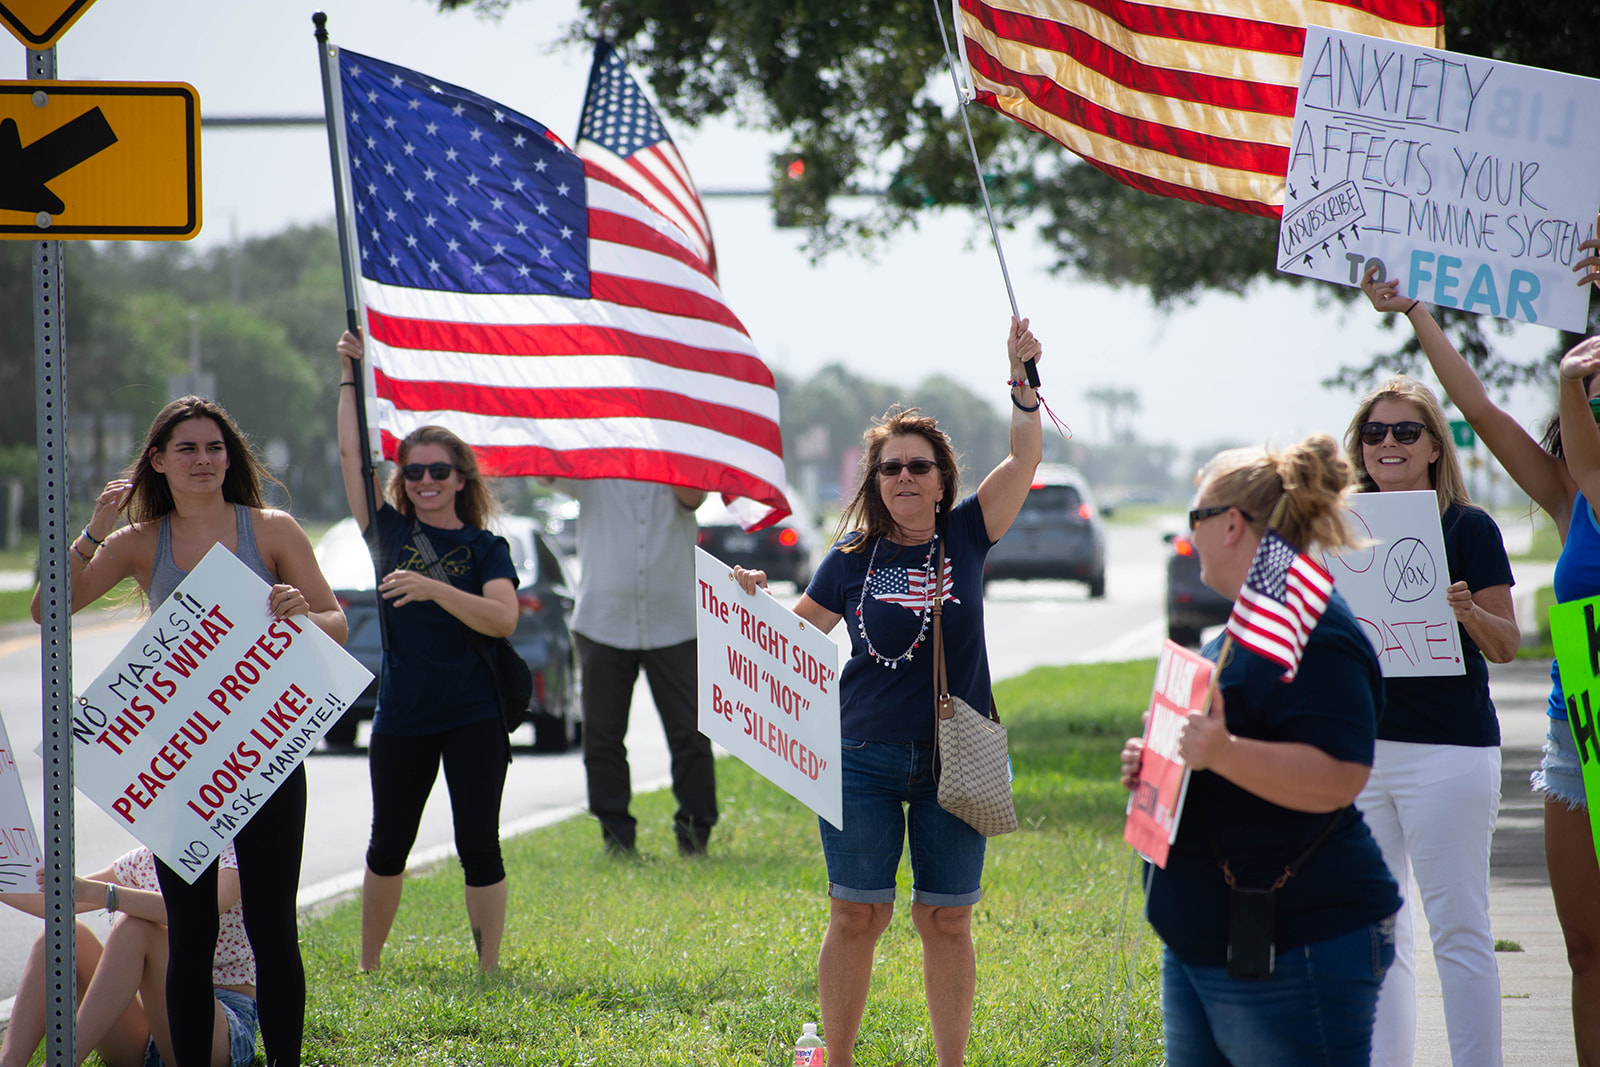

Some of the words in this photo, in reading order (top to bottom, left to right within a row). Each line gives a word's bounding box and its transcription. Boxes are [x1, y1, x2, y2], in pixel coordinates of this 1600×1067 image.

[1303, 37, 1493, 131] ANXIETY
[1290, 120, 1432, 195] AFFECTS
[1453, 147, 1547, 210] YOUR
[1281, 188, 1357, 255] UNSUBSCRIBE
[1362, 187, 1498, 252] IMMUNE
[1408, 250, 1541, 323] FEAR
[699, 579, 729, 624] The
[96, 696, 155, 755] THIS
[144, 671, 177, 704] IS
[164, 604, 235, 679] WHAT
[711, 684, 733, 723] Be
[727, 645, 758, 693] Will
[73, 703, 107, 745] NO
[112, 710, 220, 824] PEACEFUL
[207, 616, 303, 715] PROTEST
[187, 742, 261, 822] LOOKS
[250, 684, 313, 750] LIKE!
[179, 840, 209, 872] NO
[210, 788, 262, 839] MASK
[261, 693, 345, 783] MANDATE!!
